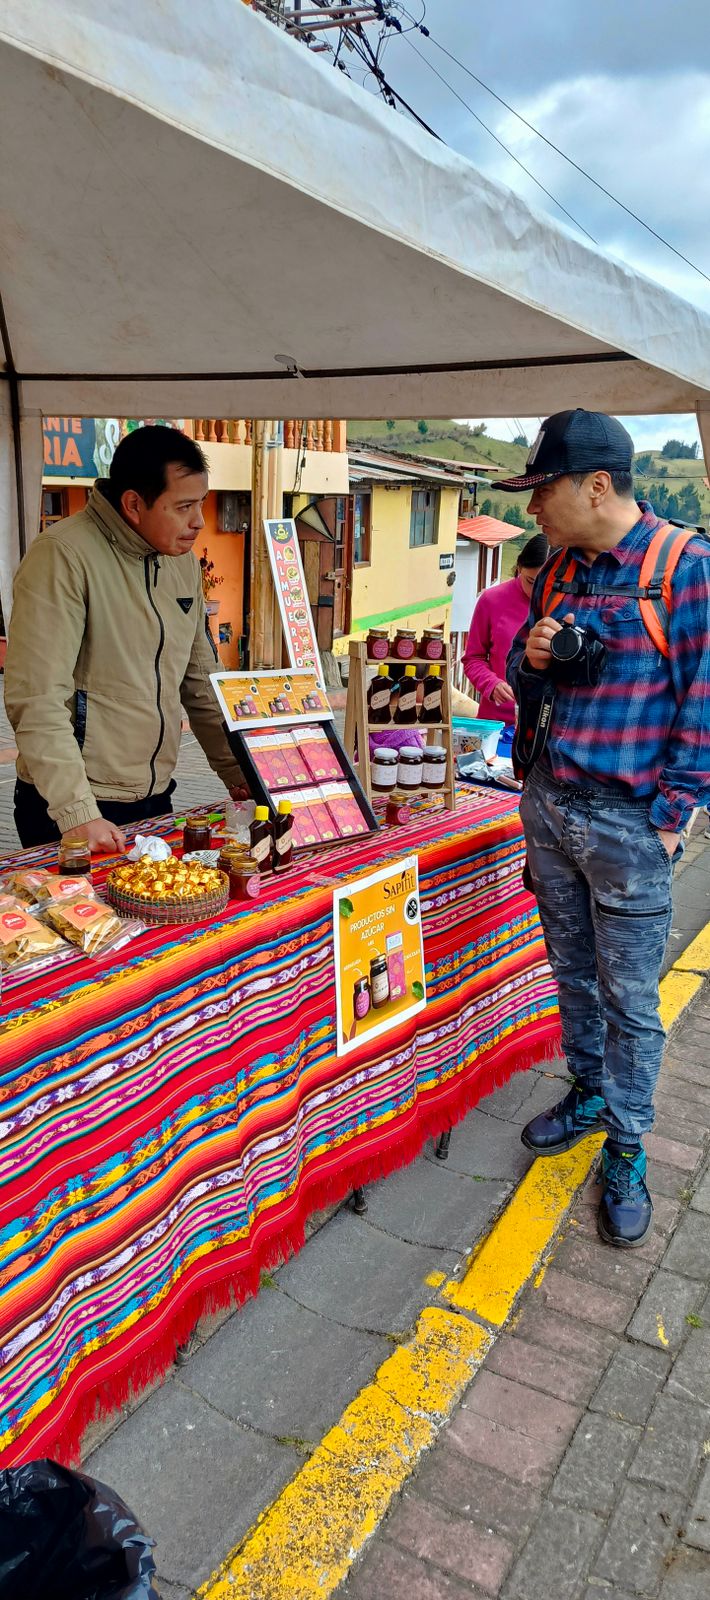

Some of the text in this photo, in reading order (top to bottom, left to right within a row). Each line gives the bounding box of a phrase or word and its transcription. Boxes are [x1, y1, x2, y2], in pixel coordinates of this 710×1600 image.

[276, 551, 303, 667] ALMUERZO
[539, 703, 551, 728] Nikon
[350, 904, 395, 932] PRODUCTOS SIN
[361, 922, 385, 940] AZÚCAR
